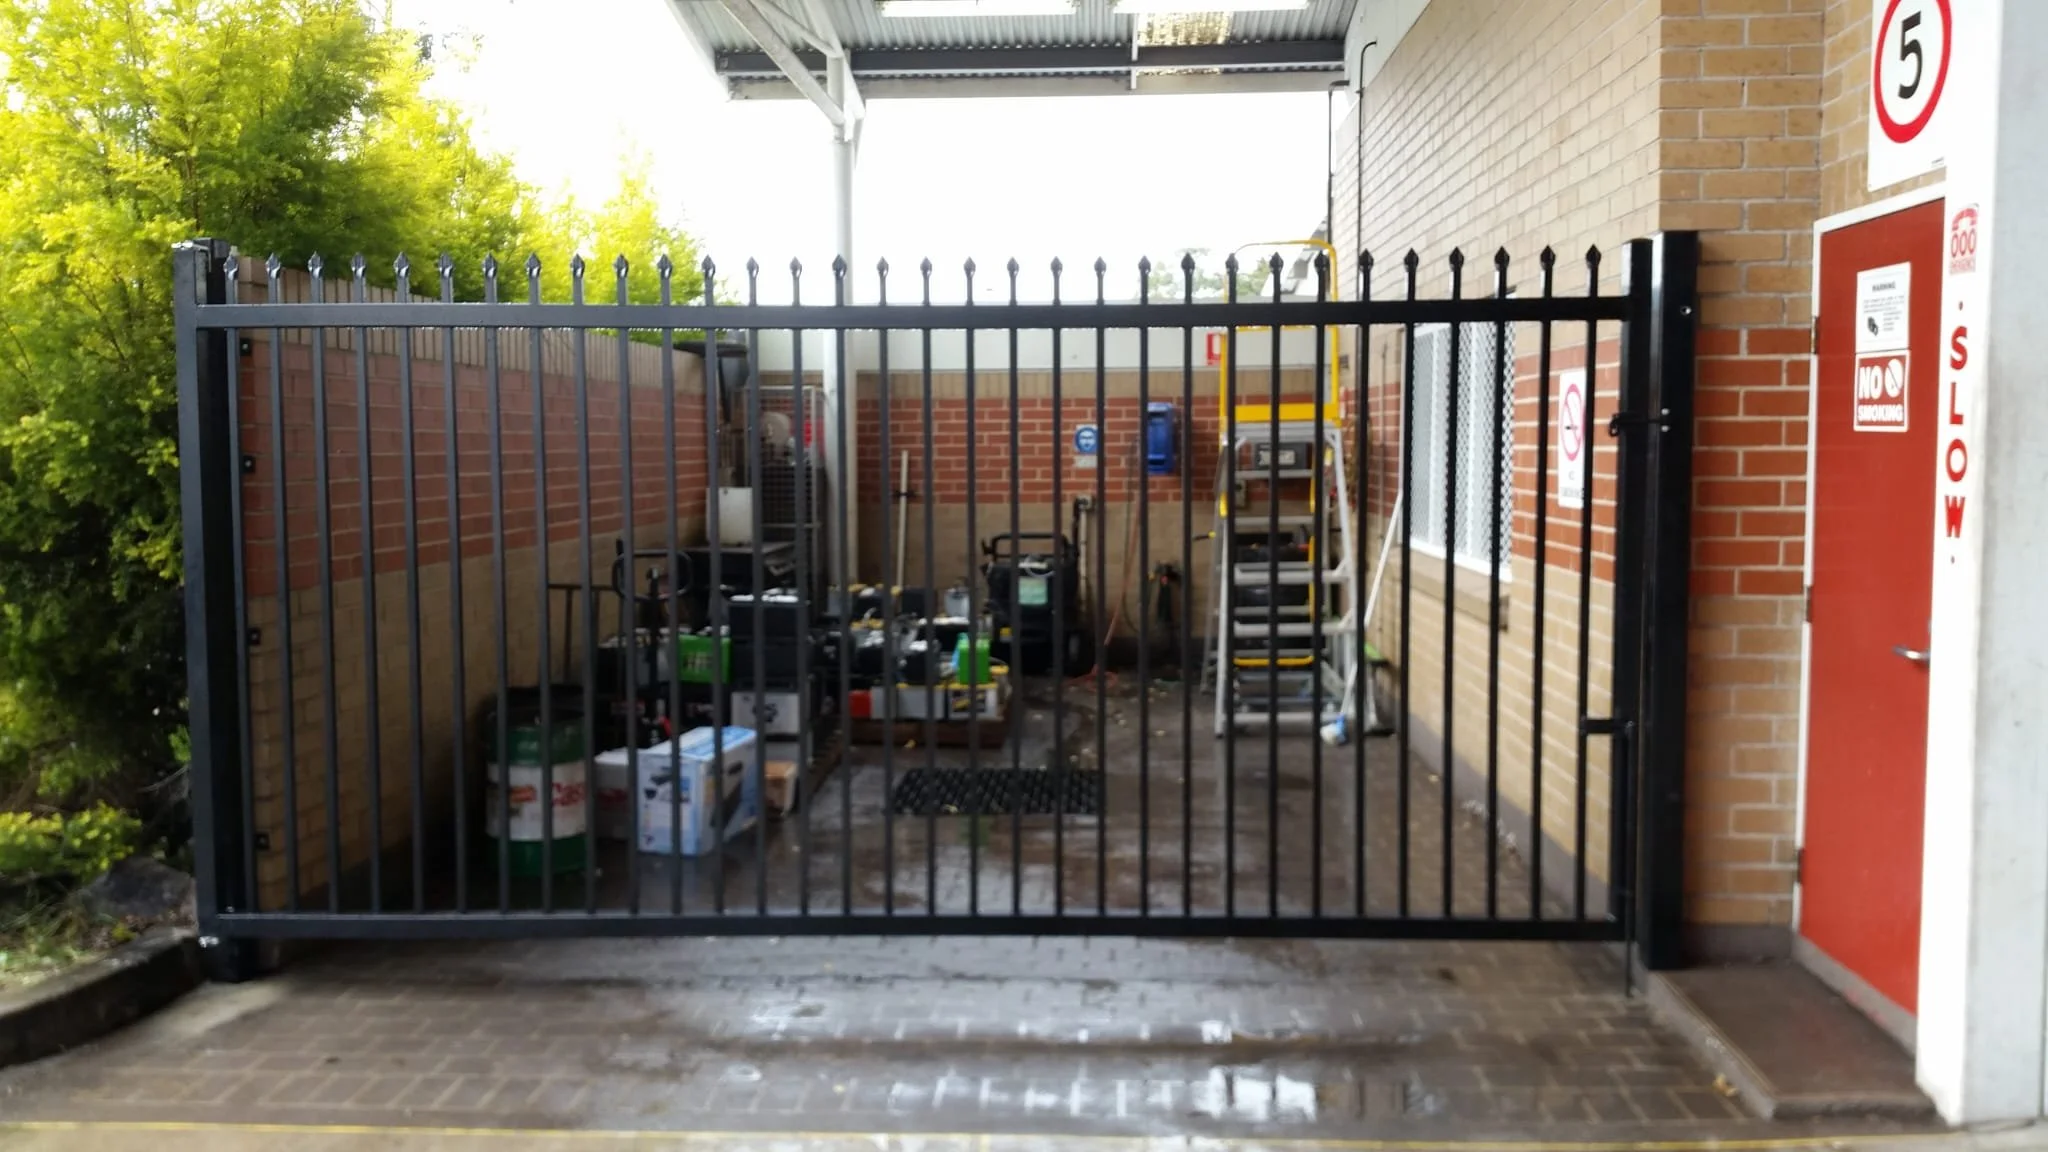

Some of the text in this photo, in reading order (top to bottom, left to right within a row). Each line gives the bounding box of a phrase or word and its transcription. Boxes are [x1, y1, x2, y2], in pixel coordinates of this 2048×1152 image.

[1898, 11, 1922, 99] 5
[1951, 228, 1976, 257] 000
[1858, 365, 1883, 400] NO
[1857, 404, 1903, 422] SMOKING
[1945, 326, 1968, 538] SLOW
